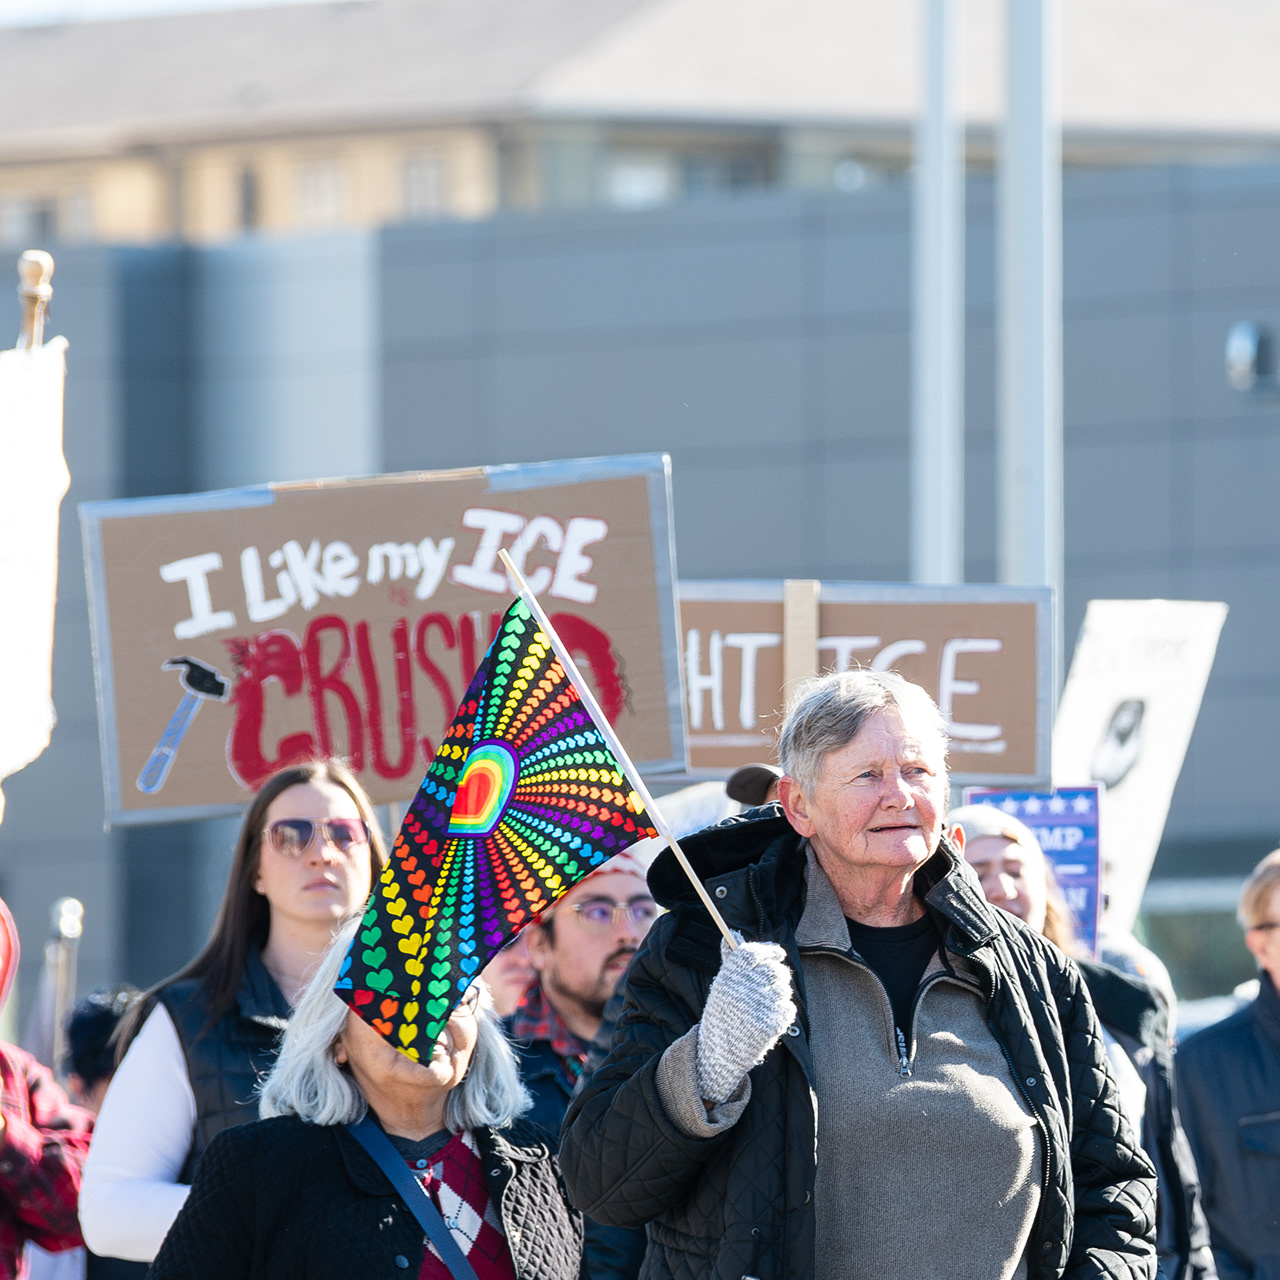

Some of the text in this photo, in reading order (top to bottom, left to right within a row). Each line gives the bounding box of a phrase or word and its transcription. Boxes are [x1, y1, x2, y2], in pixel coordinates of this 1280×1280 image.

[159, 550, 237, 642] I
[366, 535, 456, 601] my
[447, 506, 609, 604] ICE
[226, 608, 629, 794] CRUSD
